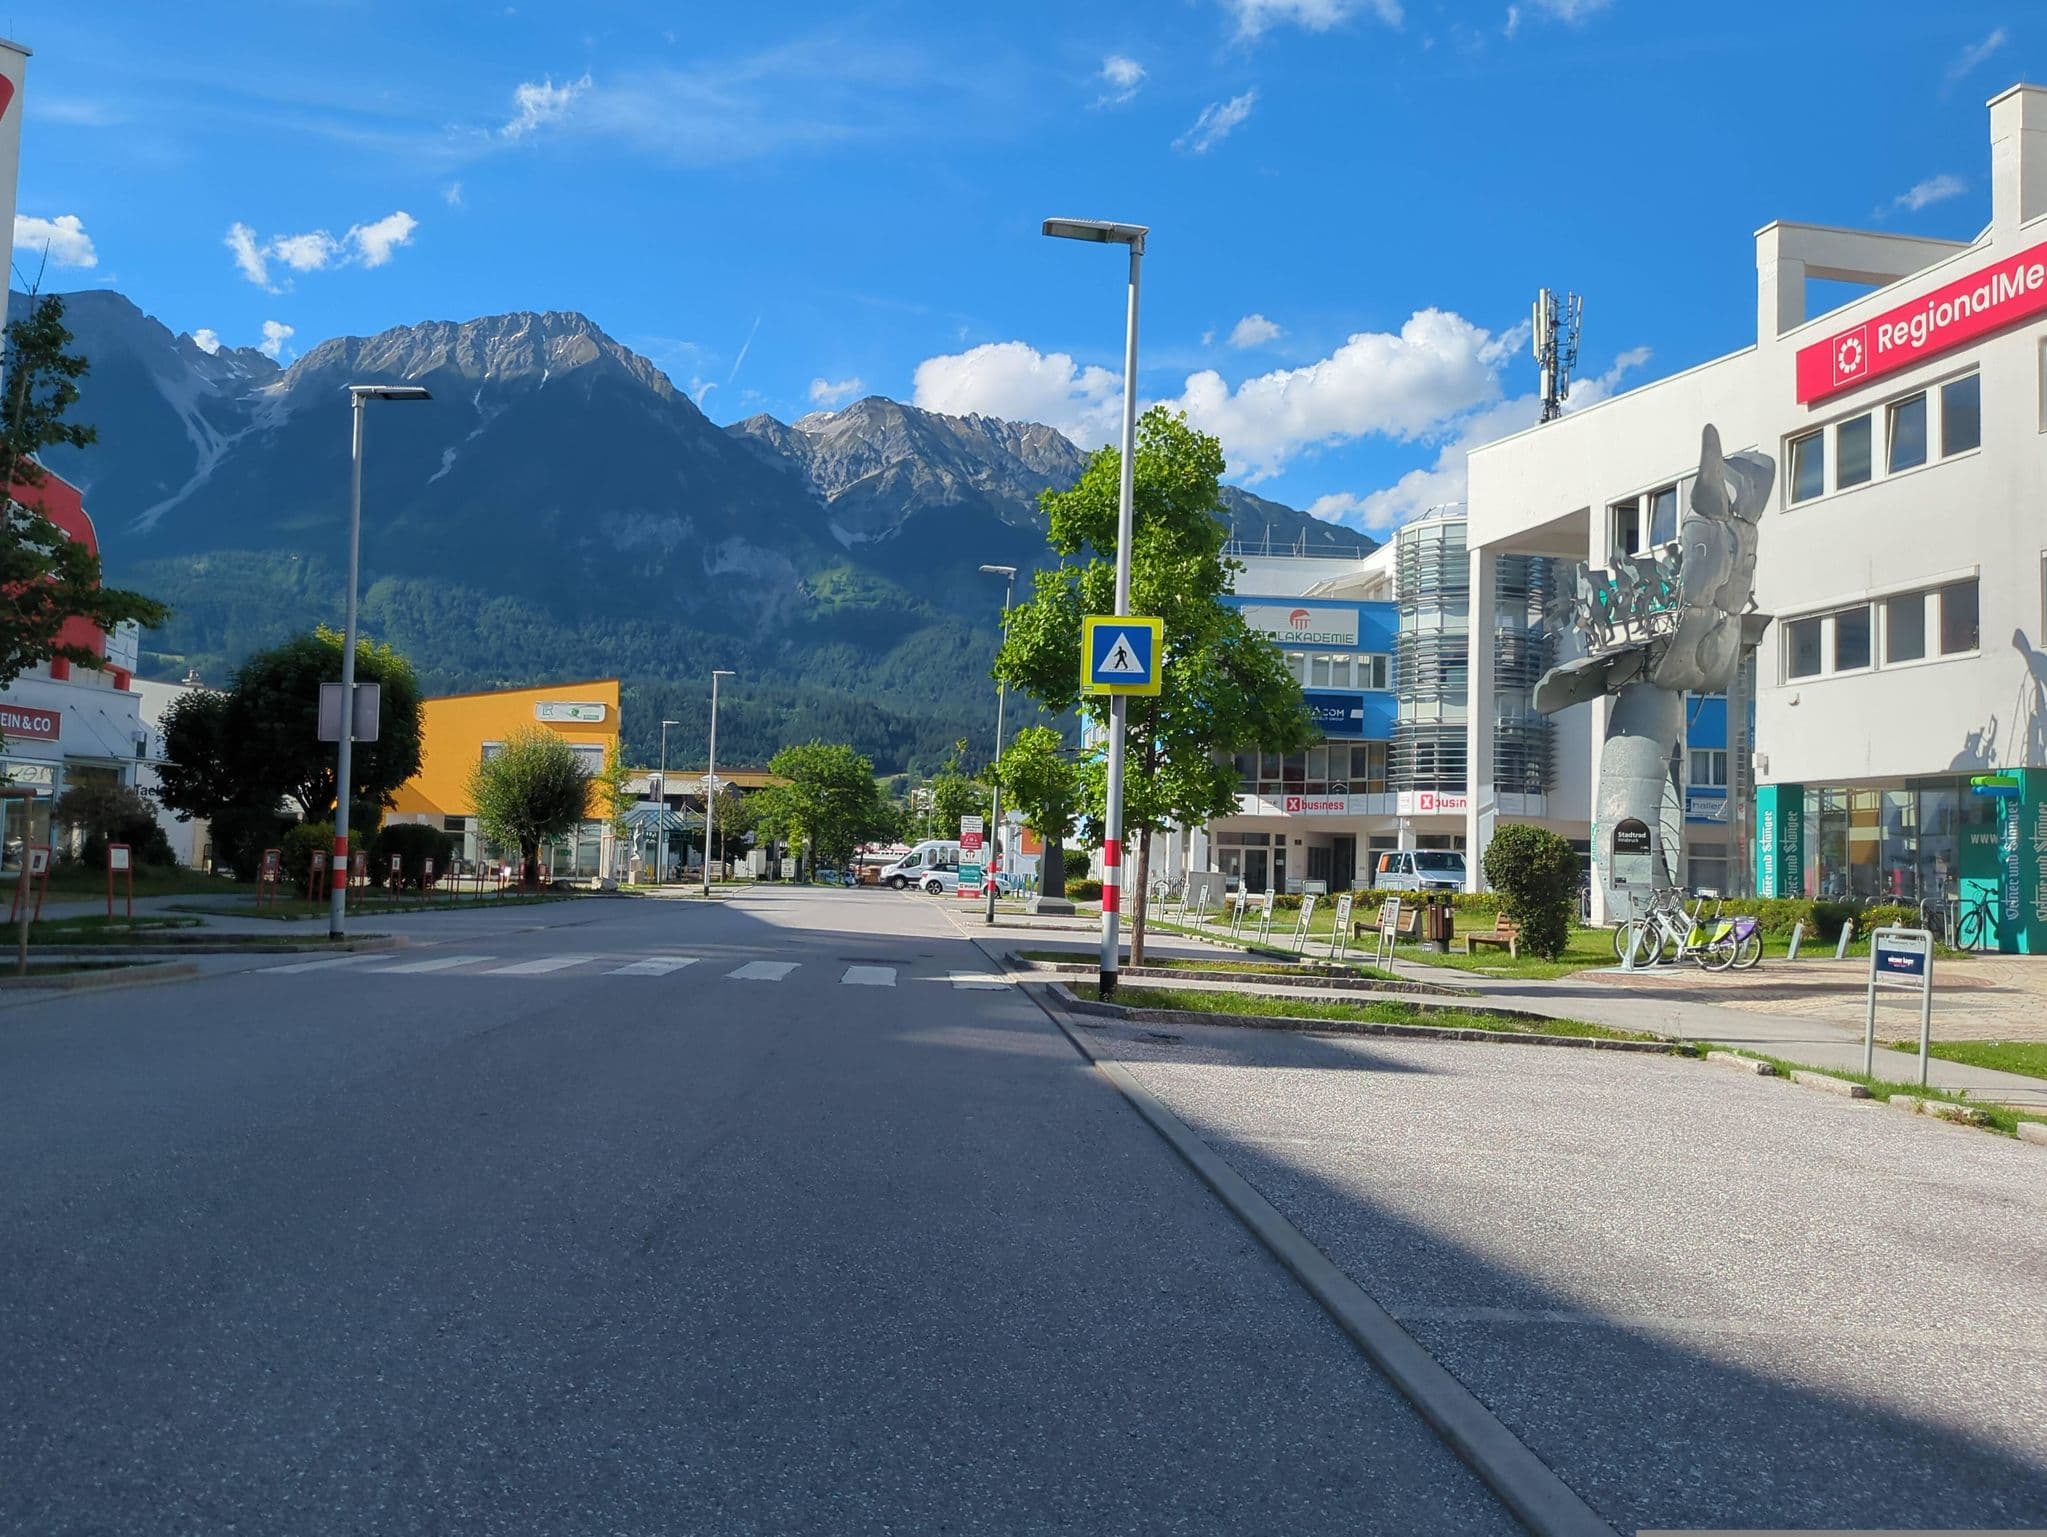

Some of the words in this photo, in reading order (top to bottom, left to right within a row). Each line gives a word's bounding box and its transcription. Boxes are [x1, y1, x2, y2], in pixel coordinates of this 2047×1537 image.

[1878, 264, 2047, 352] RegionalMe
[1, 712, 20, 728] EIN
[22, 716, 32, 730] &
[33, 717, 51, 732] CO
[1301, 799, 1345, 811] business
